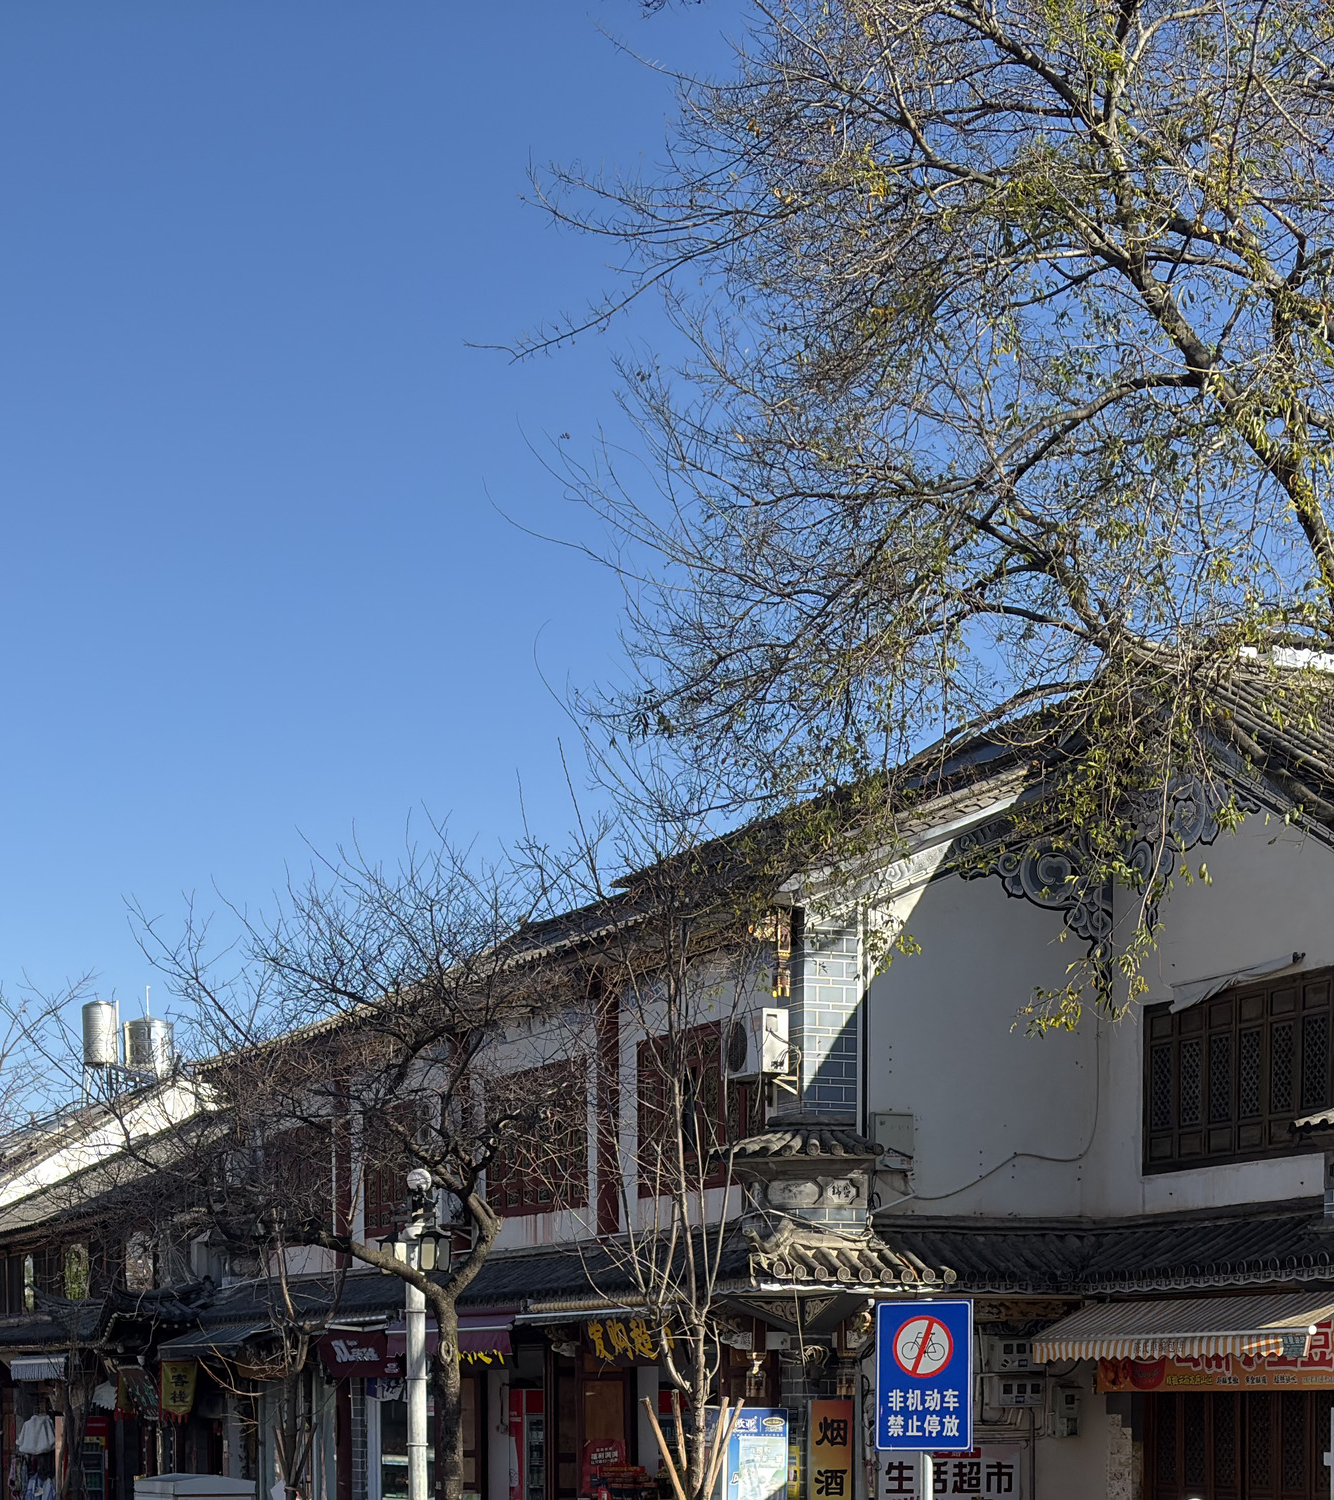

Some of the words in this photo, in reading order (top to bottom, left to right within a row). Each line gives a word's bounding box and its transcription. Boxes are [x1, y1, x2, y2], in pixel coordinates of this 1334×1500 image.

[170, 1374, 189, 1404] 客栈
[888, 1390, 959, 1411] 非机动车
[888, 1415, 959, 1437] 禁止停放
